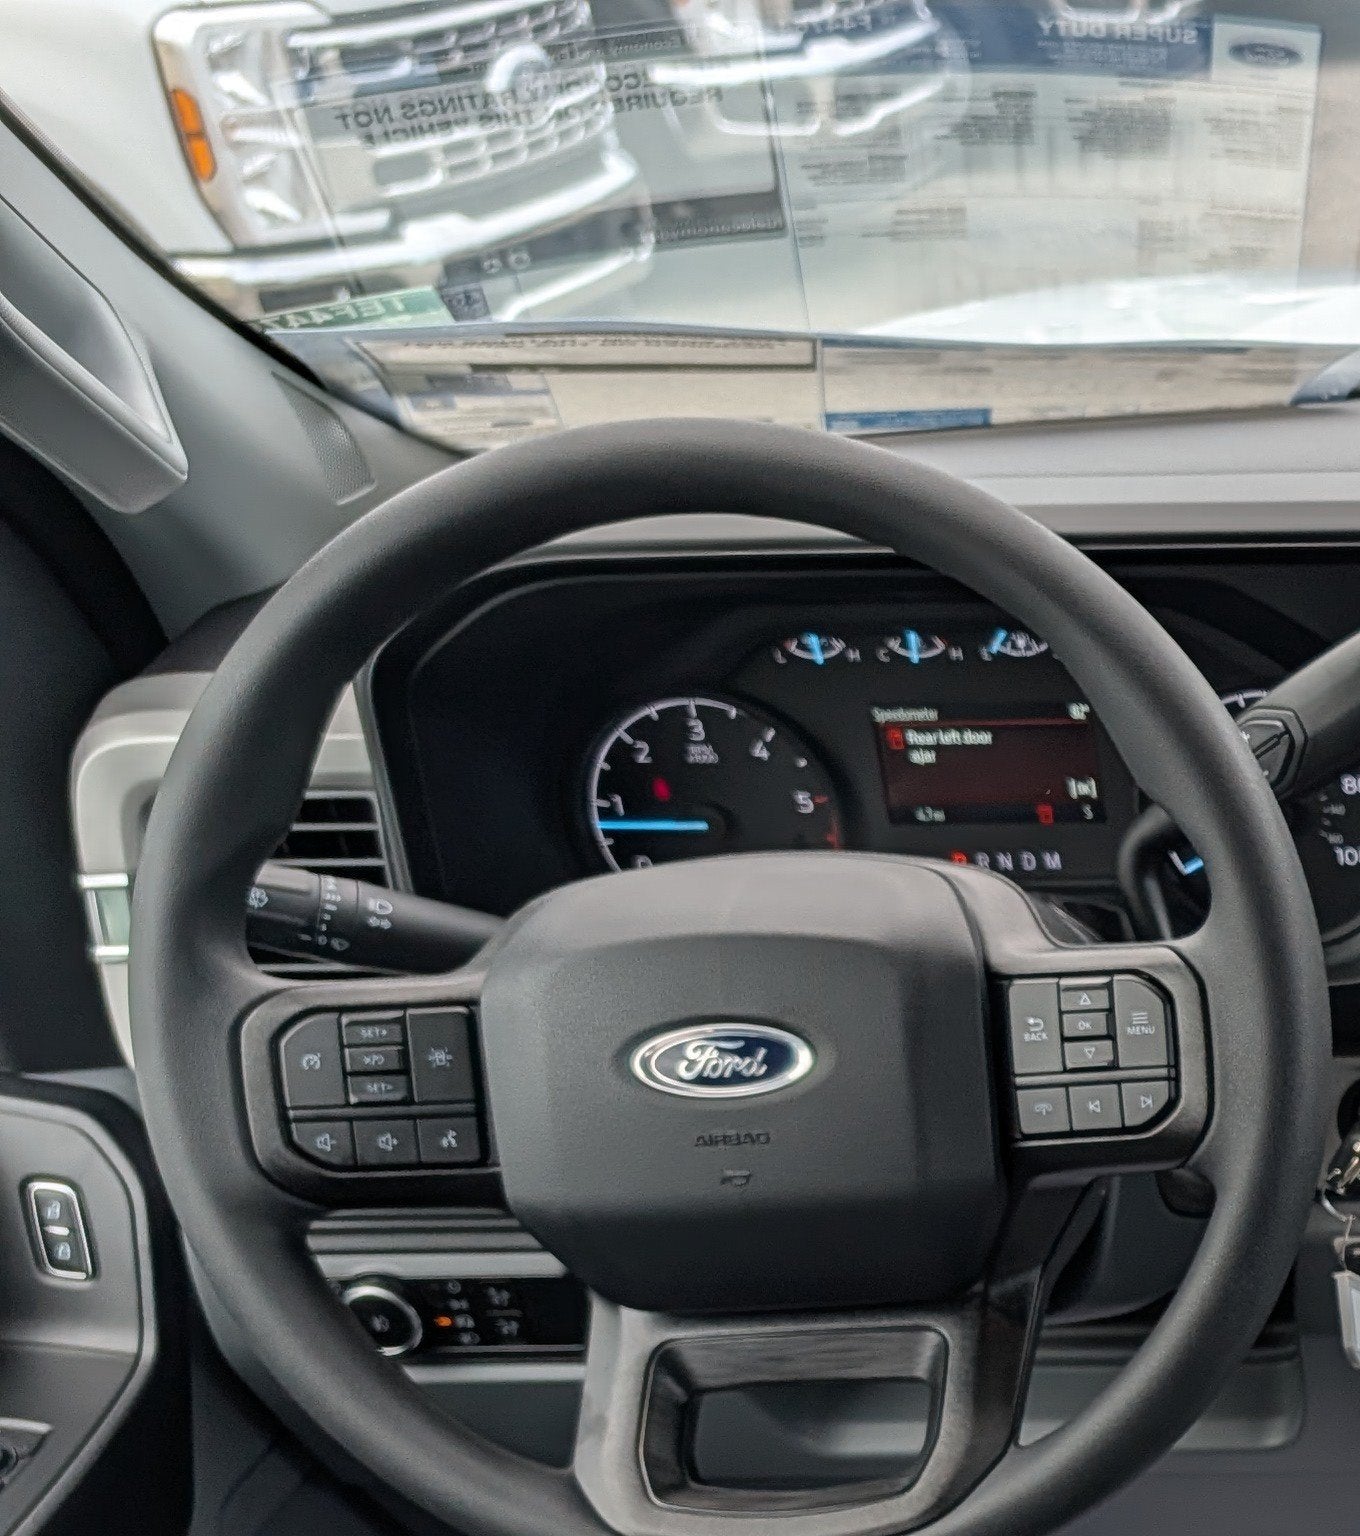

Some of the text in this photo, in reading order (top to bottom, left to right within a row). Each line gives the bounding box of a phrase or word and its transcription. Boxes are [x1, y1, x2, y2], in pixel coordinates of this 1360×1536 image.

[687, 718, 705, 741] 3
[634, 740, 652, 763] 2
[751, 739, 771, 761] 4
[609, 793, 625, 816] 1
[794, 789, 815, 814] 5
[996, 851, 1014, 871] N
[1019, 851, 1037, 872] D
[1041, 850, 1062, 871] M
[1024, 1032, 1048, 1042] BACK
[1126, 1026, 1155, 1036] MENU
[676, 1039, 768, 1081] Ford
